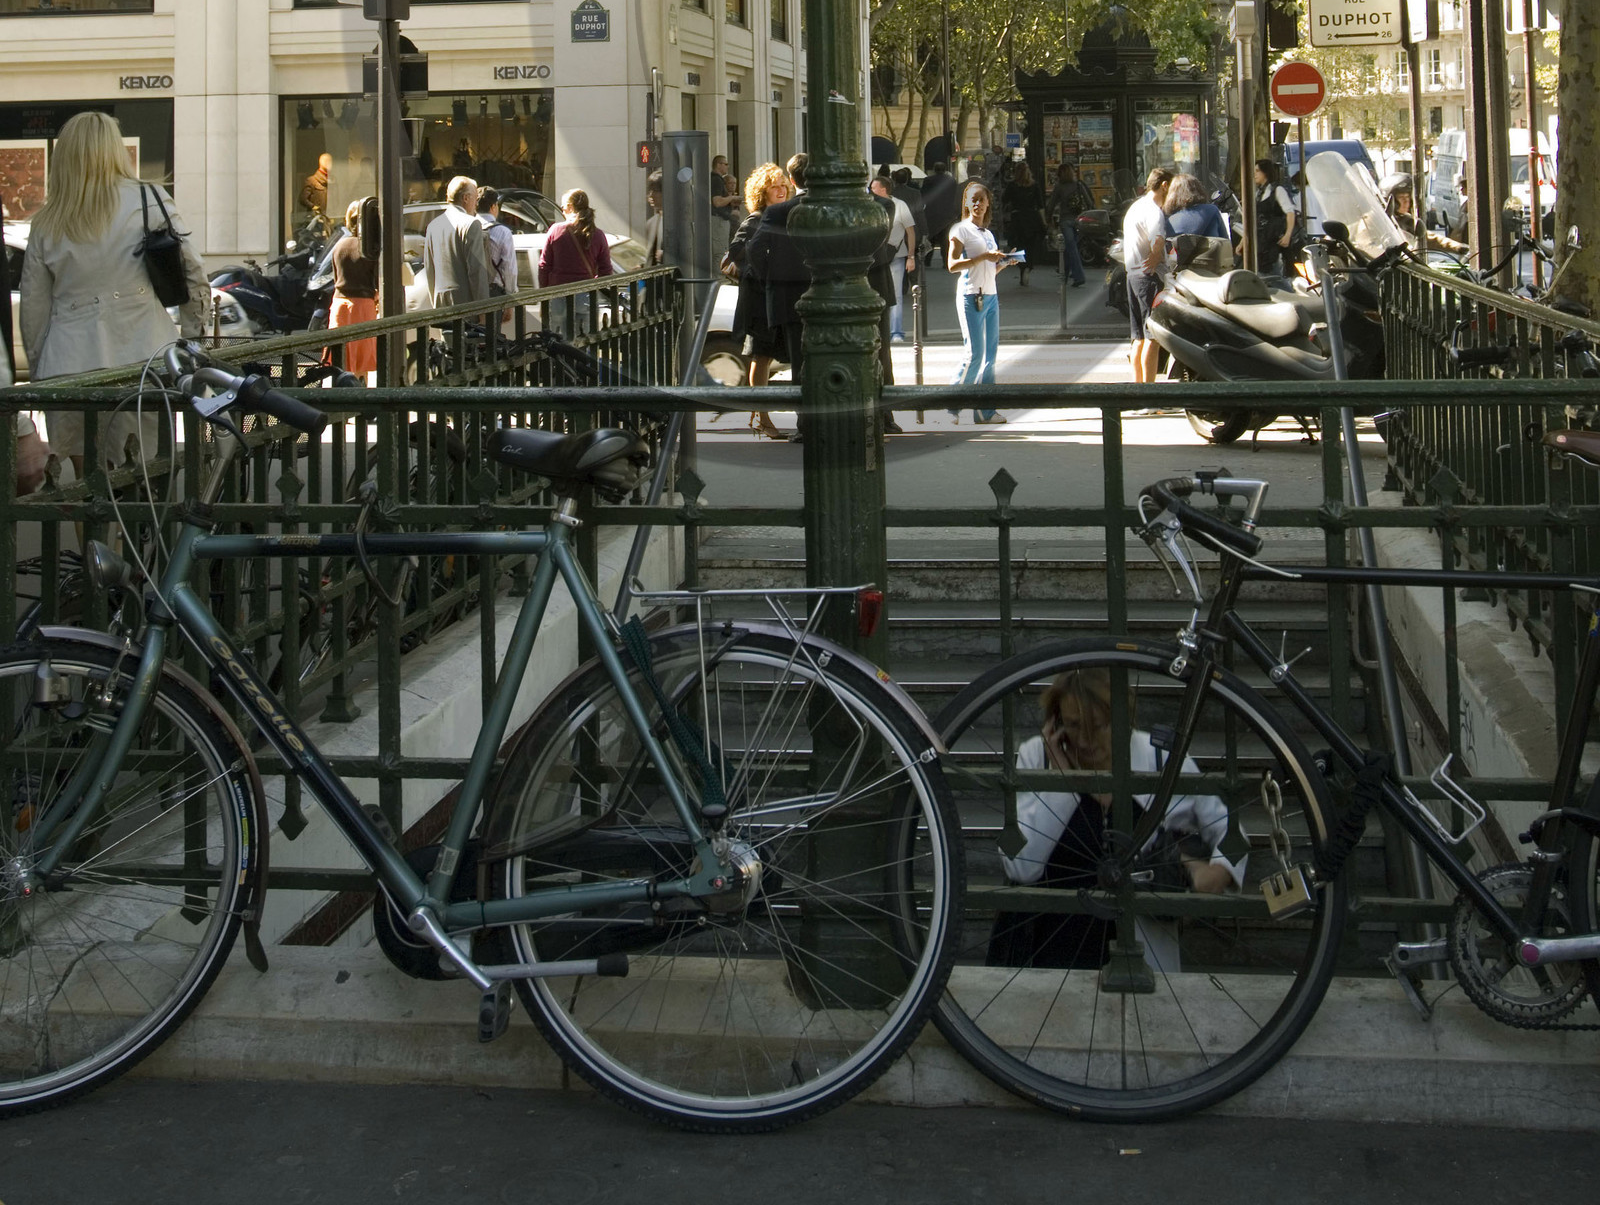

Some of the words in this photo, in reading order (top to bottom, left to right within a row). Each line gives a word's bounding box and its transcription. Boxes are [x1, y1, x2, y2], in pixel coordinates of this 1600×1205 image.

[582, 14, 599, 23] RUE
[1319, 12, 1392, 27] DUPHOT
[574, 23, 606, 31] DUPHOT
[1381, 31, 1392, 39] 26
[494, 65, 551, 80] KENZO
[119, 75, 173, 90] KENZO
[209, 636, 304, 752] Gazelle
